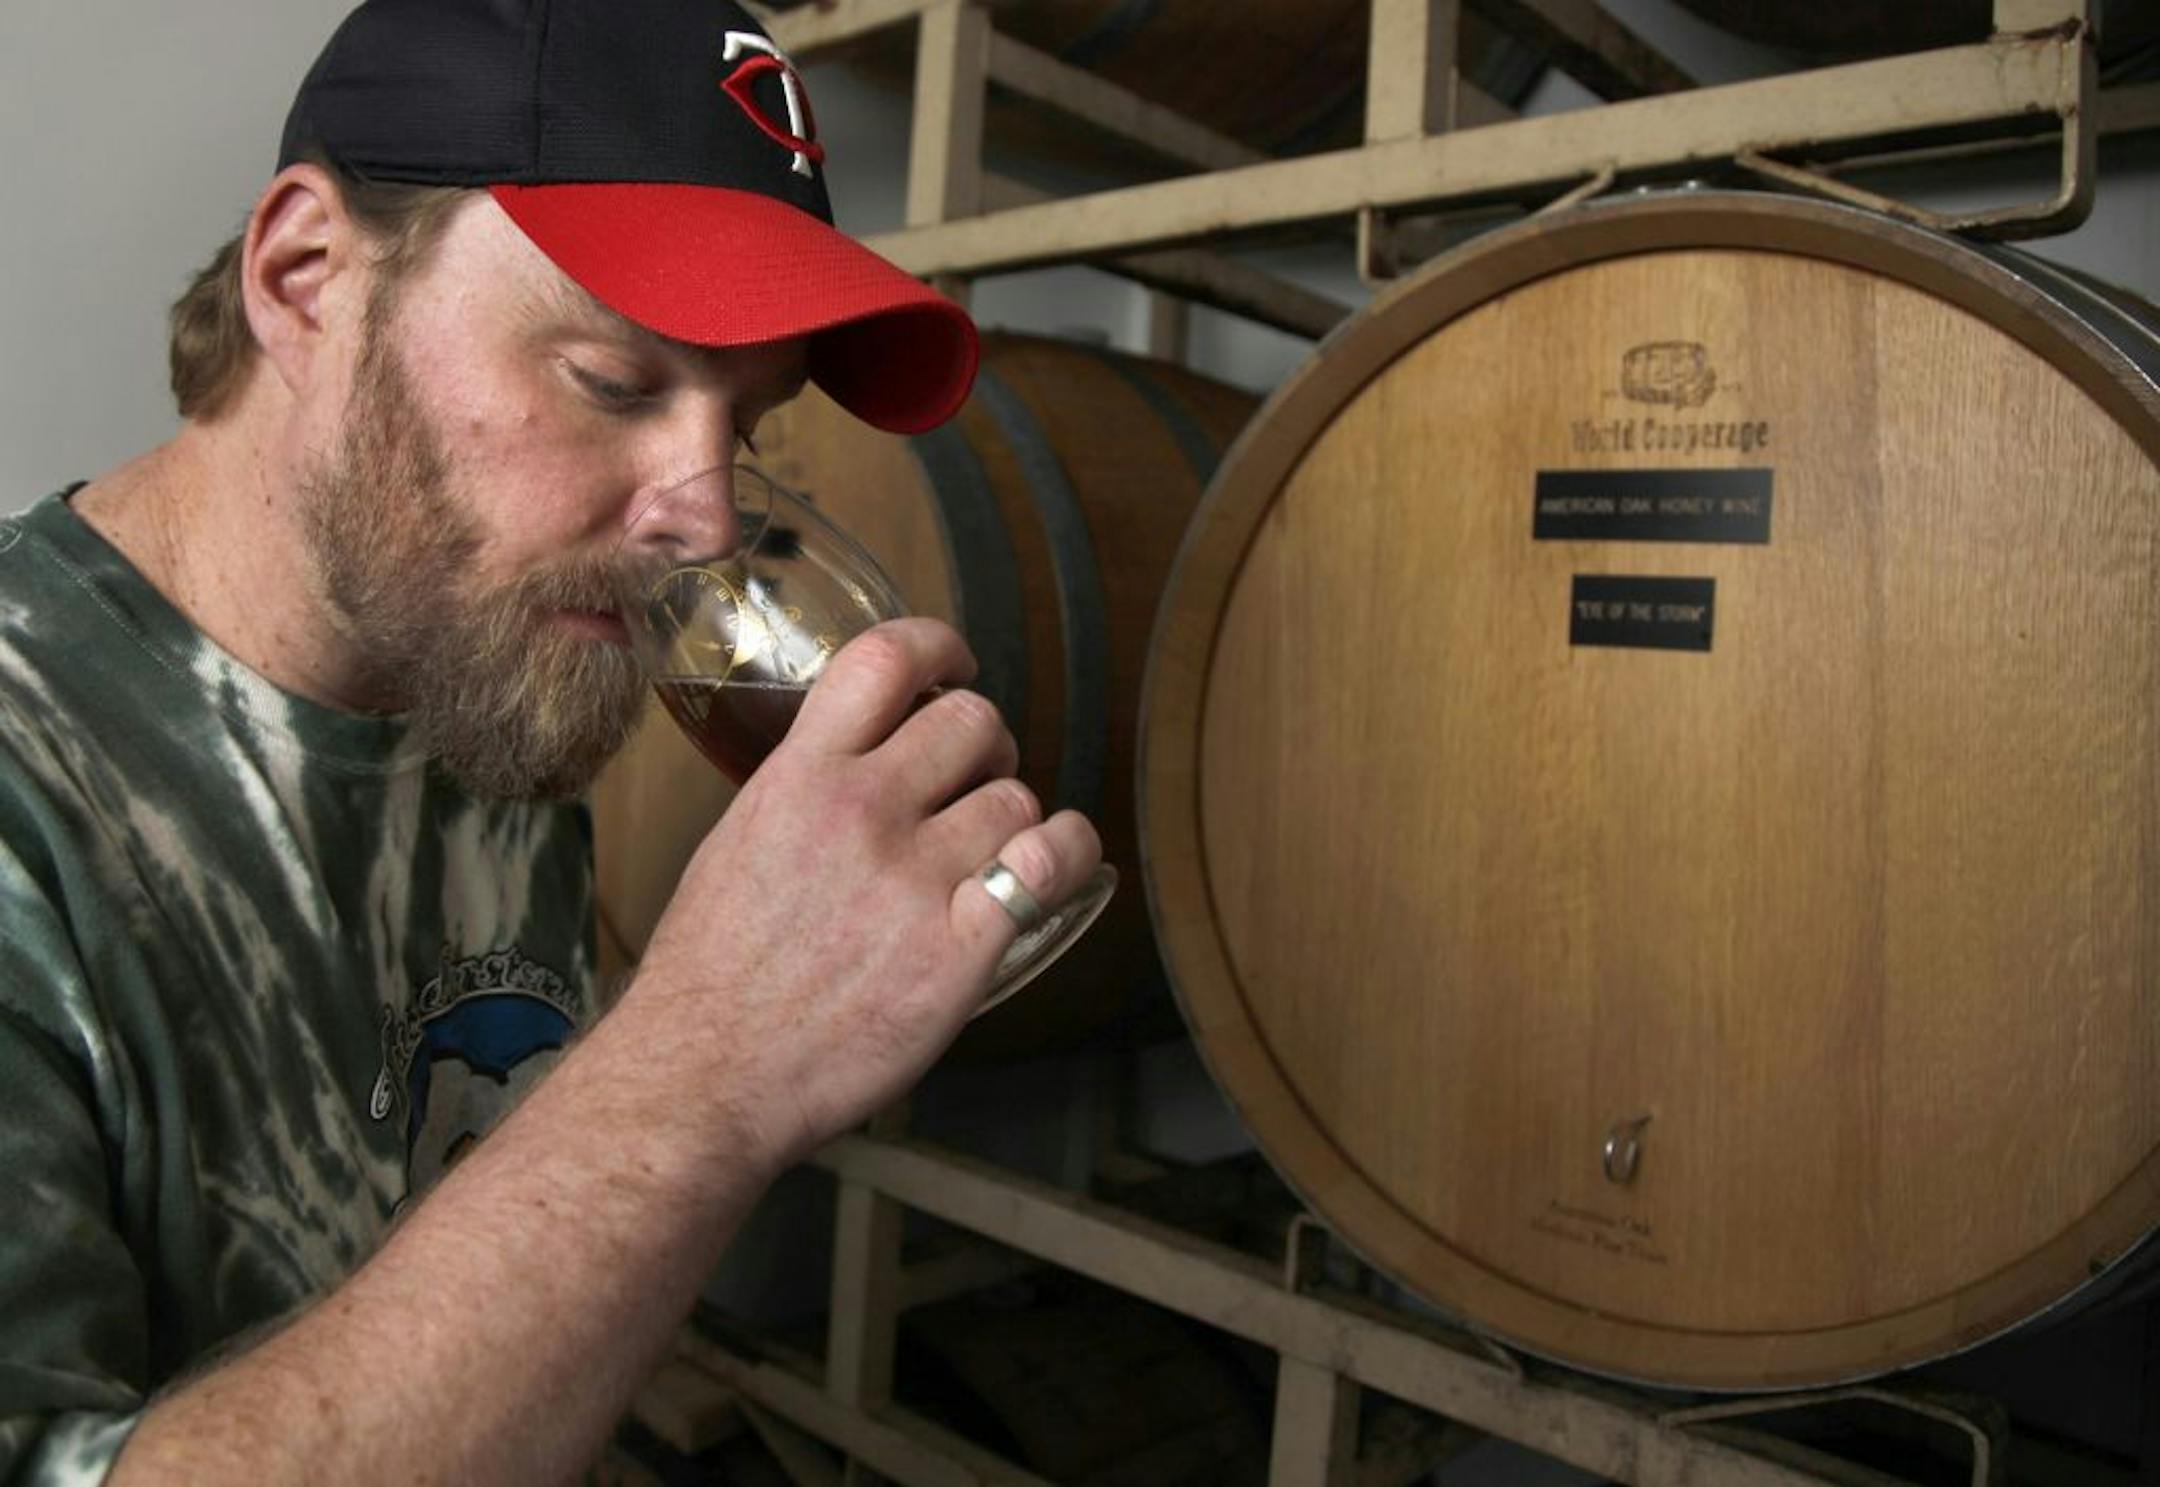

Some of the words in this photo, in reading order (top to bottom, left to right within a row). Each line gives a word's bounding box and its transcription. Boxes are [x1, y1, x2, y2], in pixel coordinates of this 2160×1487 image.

[1571, 417, 1635, 453] World
[1644, 417, 1769, 455] Cooperage
[1540, 497, 1615, 515] AMERICAN
[1620, 497, 1651, 515] OAK
[1658, 497, 1714, 515] HONEY
[1608, 601, 1625, 621] OF
[1630, 601, 1653, 623] THE
